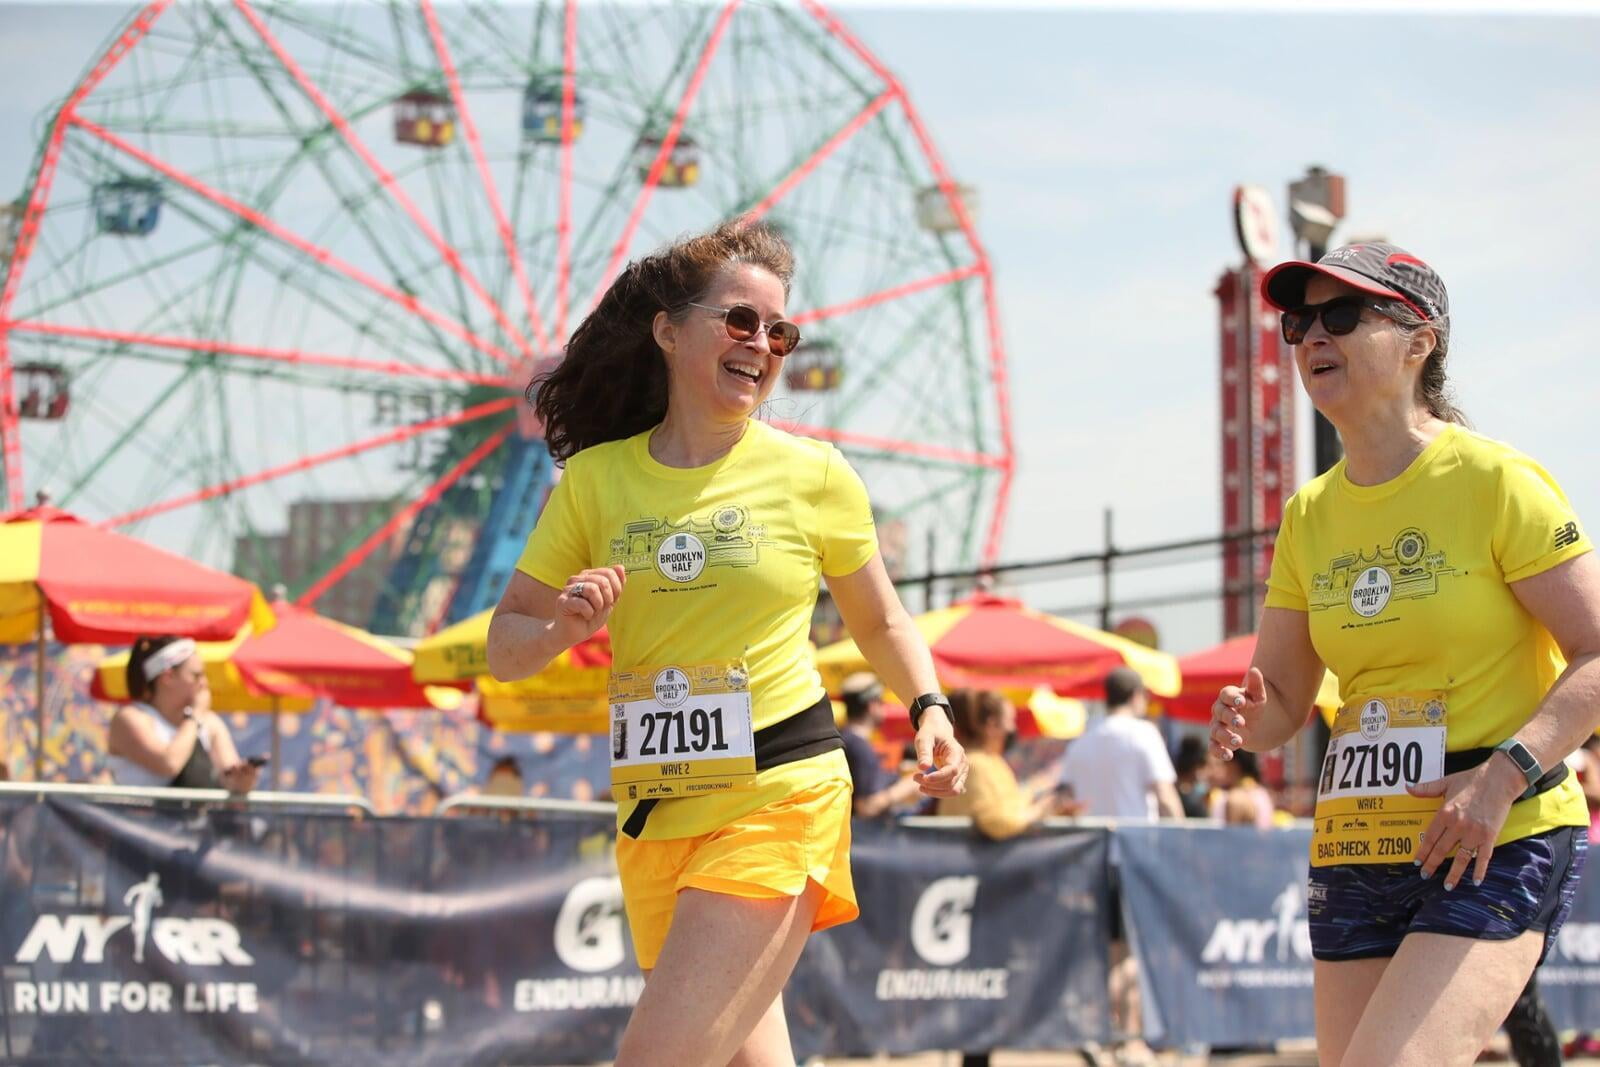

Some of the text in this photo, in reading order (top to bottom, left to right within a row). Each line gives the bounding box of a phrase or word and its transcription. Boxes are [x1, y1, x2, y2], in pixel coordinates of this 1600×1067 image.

[660, 551, 703, 564] BROOKLYN
[671, 562, 692, 572] HALF
[1353, 585, 1390, 599] BROOKLYN
[1361, 597, 1379, 607] HALF
[655, 682, 688, 694] BROOKLYN
[663, 691, 679, 699] HALF
[1362, 715, 1387, 726] BROOKLYN
[639, 707, 729, 756] 27191
[1367, 723, 1380, 732] HALF
[661, 763, 690, 776] WAVE 2
[1338, 742, 1422, 789] 27190
[1357, 798, 1384, 811] WAVE 2
[1318, 837, 1412, 859] BAG CHECK 27190
[911, 875, 979, 966] G
[875, 968, 1009, 1000] ENDURANCE
[14, 981, 259, 1013] RUN FOR LIFE
[514, 975, 646, 1011] ENDURAN
